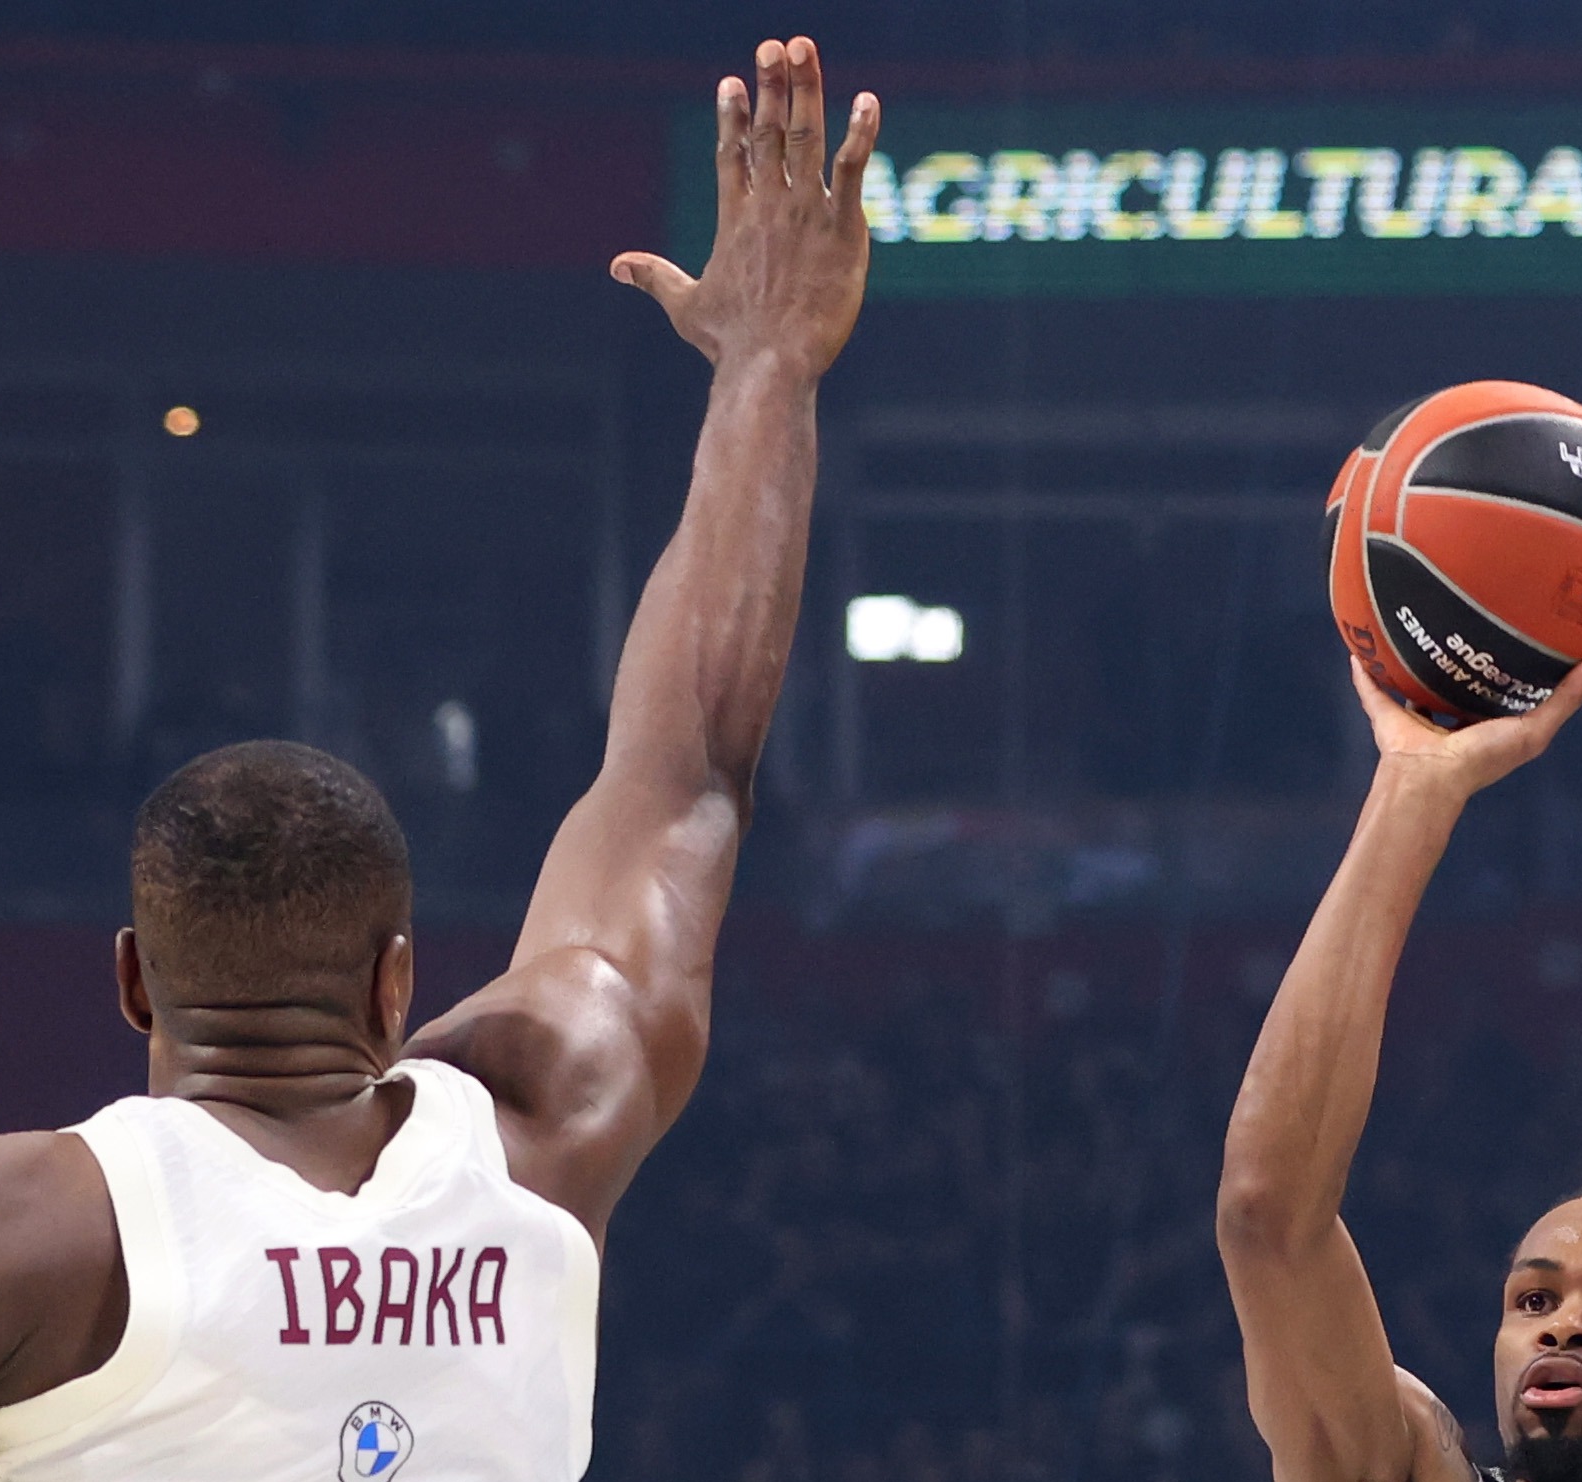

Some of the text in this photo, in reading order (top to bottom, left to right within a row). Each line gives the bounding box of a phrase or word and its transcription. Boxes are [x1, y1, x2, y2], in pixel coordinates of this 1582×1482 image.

[1395, 605, 1472, 683] AIRLINES
[265, 1246, 508, 1346] IBAKA
[350, 1406, 404, 1432] BMW
